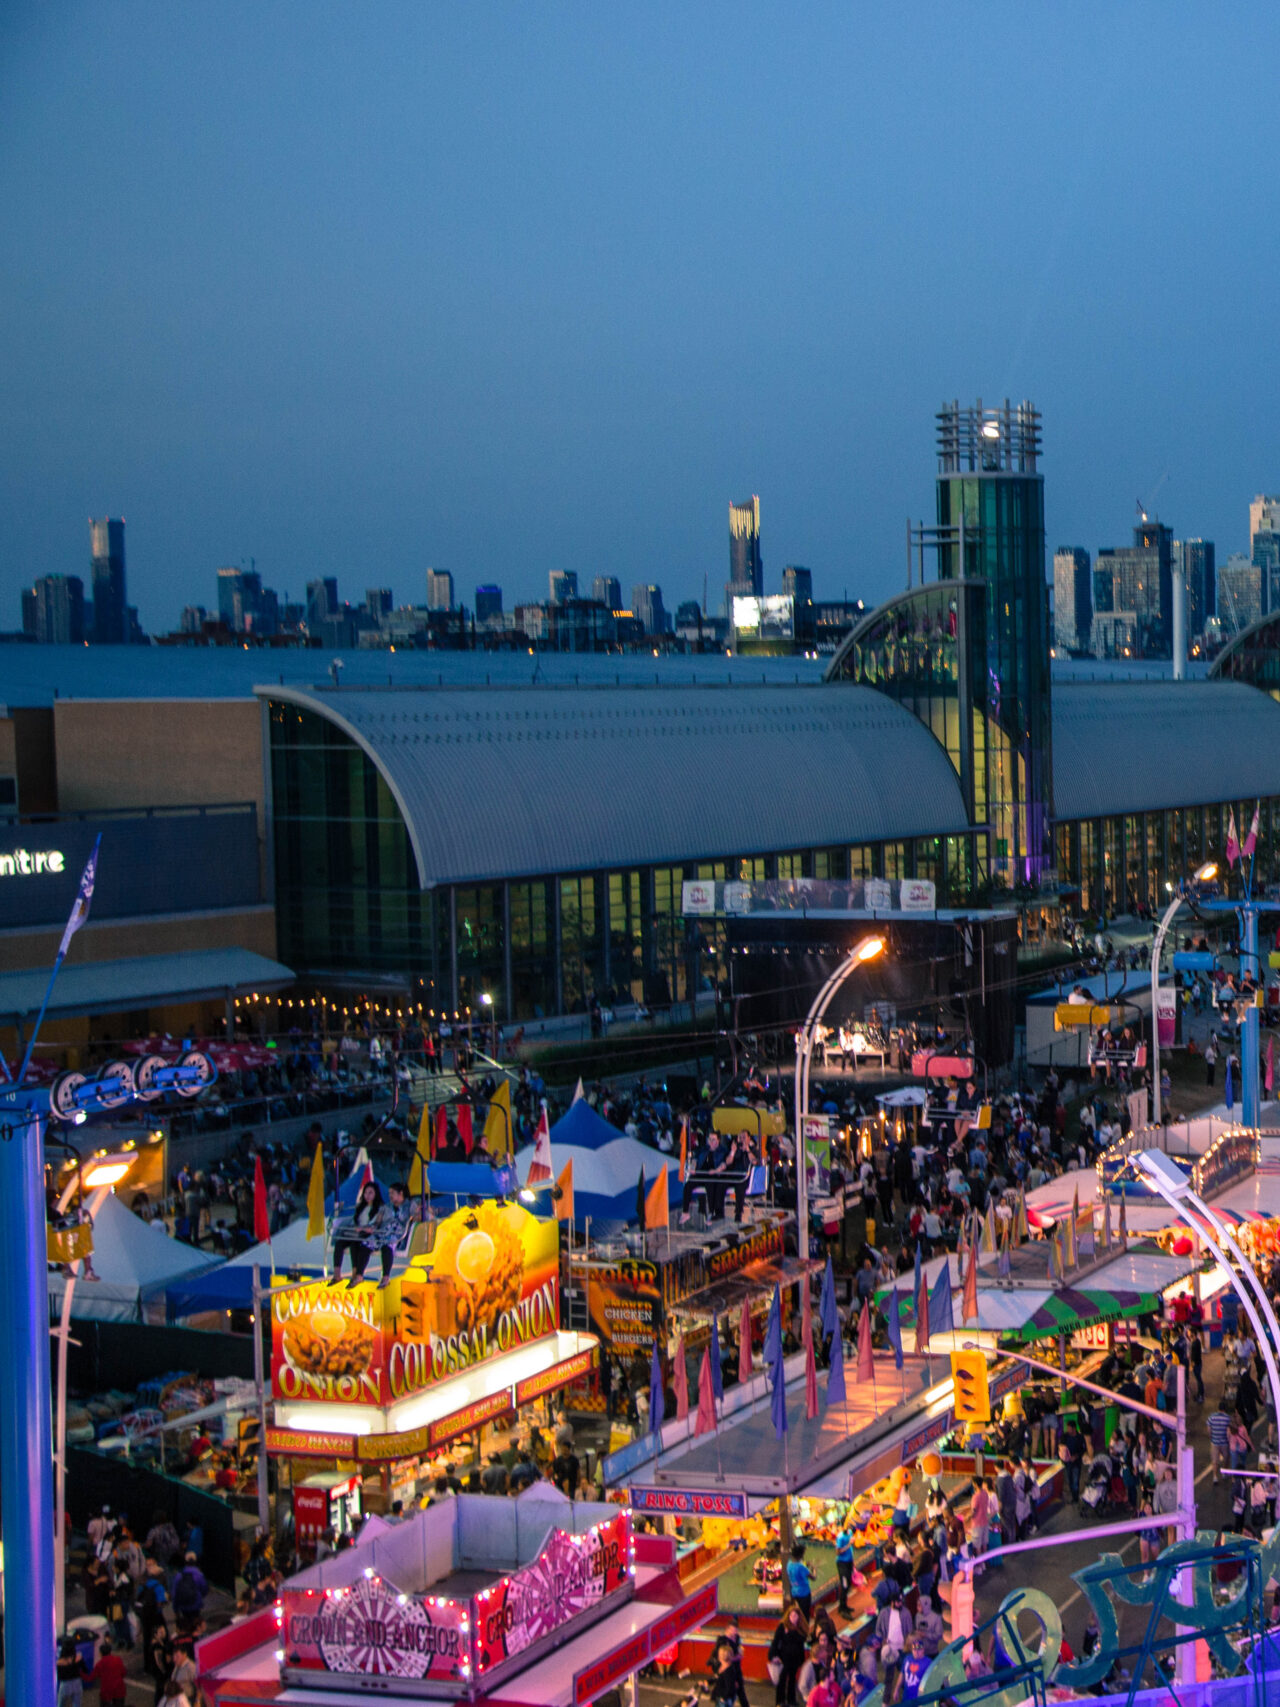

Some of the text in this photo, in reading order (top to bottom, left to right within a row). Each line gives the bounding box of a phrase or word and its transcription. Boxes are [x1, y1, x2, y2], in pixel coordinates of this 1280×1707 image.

[276, 1288, 381, 1331] COLOSSAL
[604, 1308, 653, 1321] CHICKEN
[389, 1276, 557, 1398] COLOSSAL ONION
[278, 1362, 382, 1405] ONION
[645, 1492, 733, 1514] RING TOSS
[290, 1614, 460, 1660] CROWN AND ANCHOR
